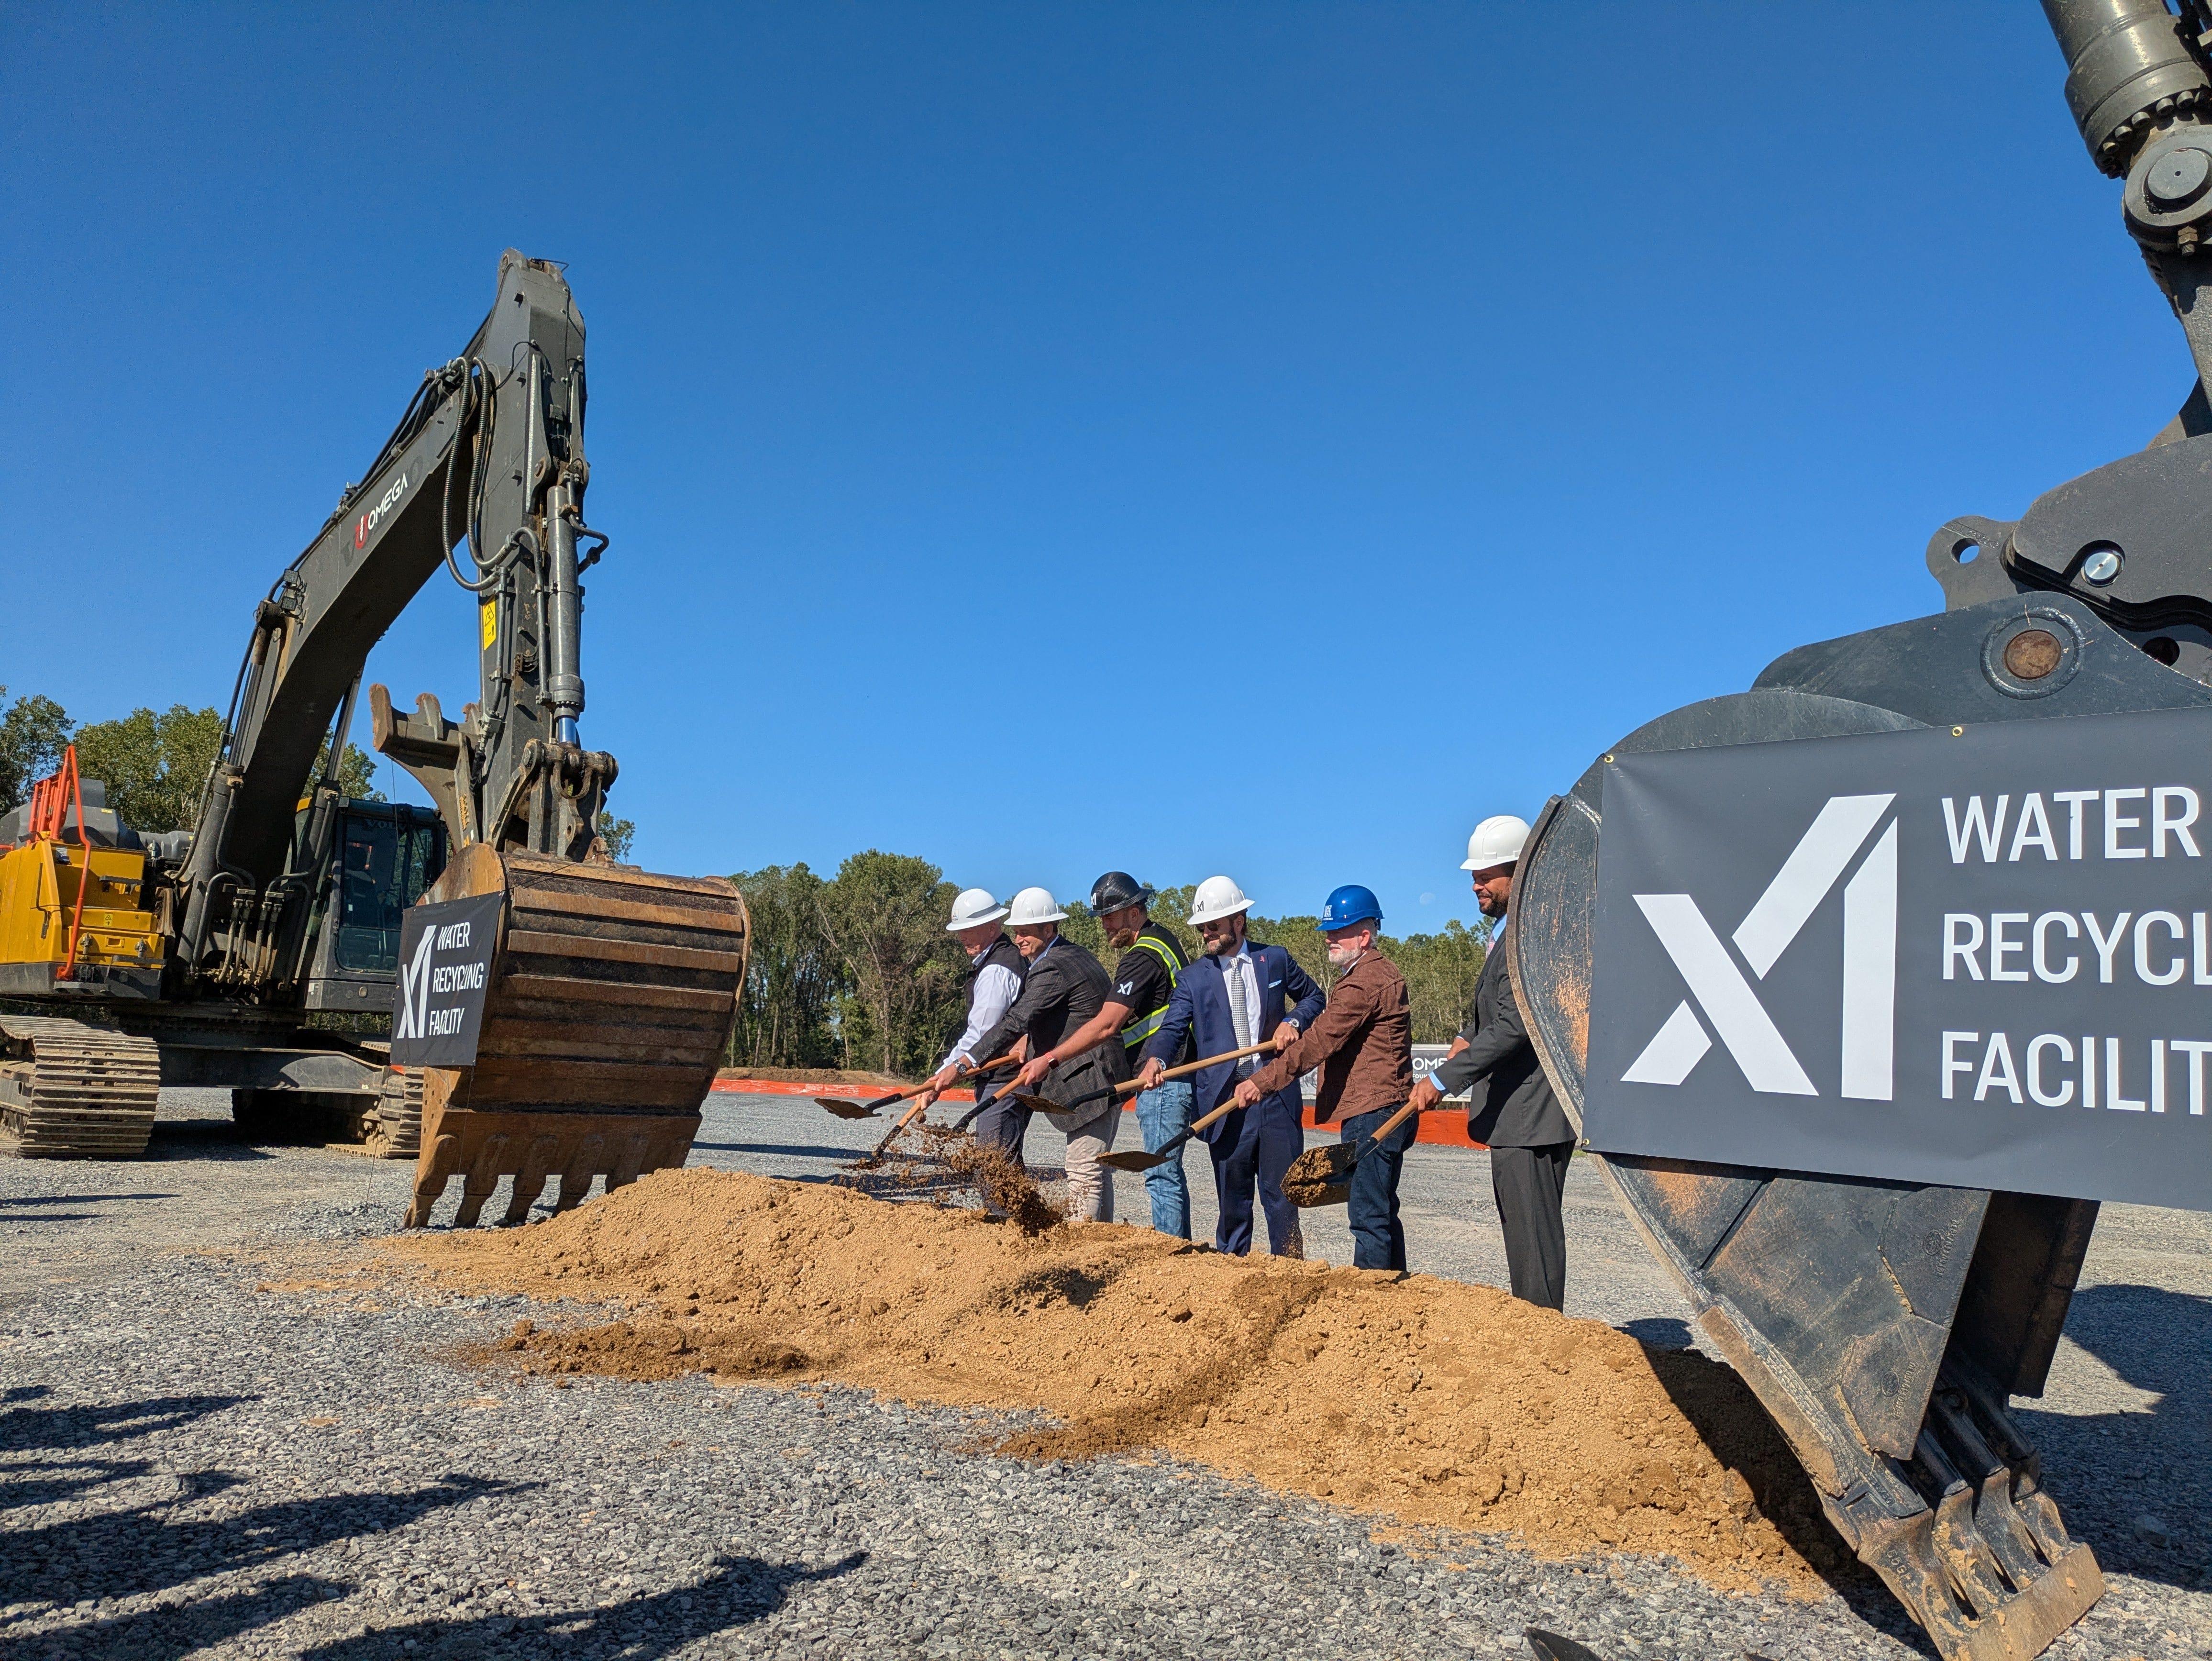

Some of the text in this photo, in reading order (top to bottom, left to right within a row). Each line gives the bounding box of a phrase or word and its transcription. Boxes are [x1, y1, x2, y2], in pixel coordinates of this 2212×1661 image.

[368, 472, 408, 530] OMEGA
[364, 819, 408, 831] VOLV
[1941, 786, 2201, 864] WATER
[437, 921, 470, 951] WATER
[432, 962, 484, 993] RECYCLING
[429, 1008, 465, 1036] FACILITY
[1941, 1030, 2212, 1116] FACILIT
